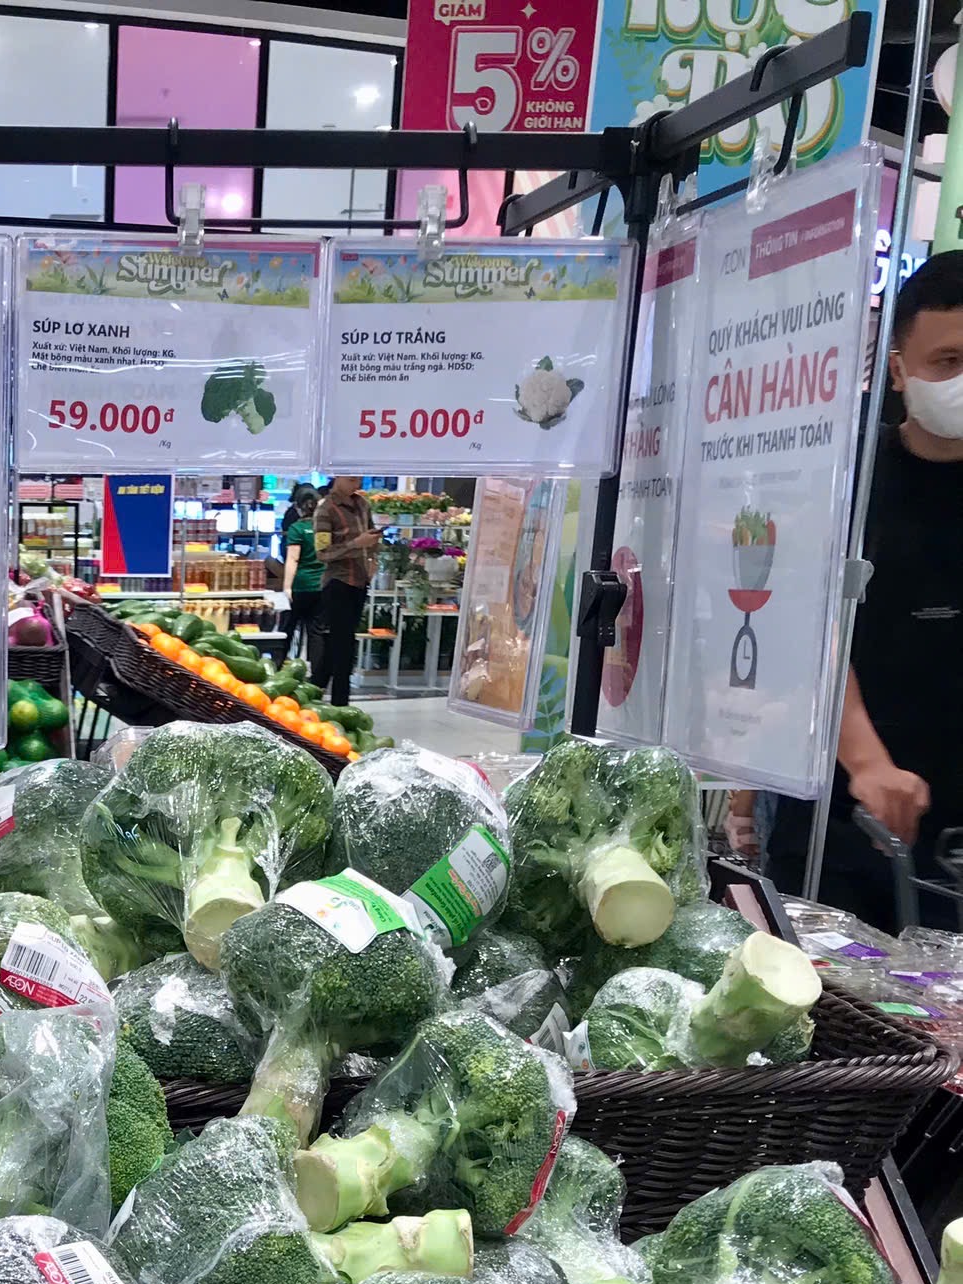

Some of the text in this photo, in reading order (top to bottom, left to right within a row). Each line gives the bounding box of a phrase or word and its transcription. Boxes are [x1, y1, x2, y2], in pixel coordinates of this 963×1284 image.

[526, 99, 574, 113] KHÔNG
[524, 116, 582, 130] GIỚI HẠN
[118, 255, 235, 295] Summer
[424, 257, 541, 298] Summer
[32, 318, 130, 338] SÚP LƠ XANH
[341, 327, 446, 345] SÚP LƠ TRẮNG
[709, 291, 845, 355] QUÝ KHÁCH VUI LÒNG
[32, 341, 52, 351] Xuất
[69, 343, 86, 353] Việt
[88, 345, 110, 354] Nam.
[162, 349, 177, 358] KG.
[341, 352, 361, 361] Xuất
[378, 352, 395, 362] Việt
[704, 342, 840, 425] CÂN HÀNG
[48, 400, 175, 434] 59.000đ
[358, 408, 485, 438] 55.000đ
[700, 414, 834, 462] TRƯỚC KHI THANH TOÁN
[2, 974, 36, 996] ÆON
